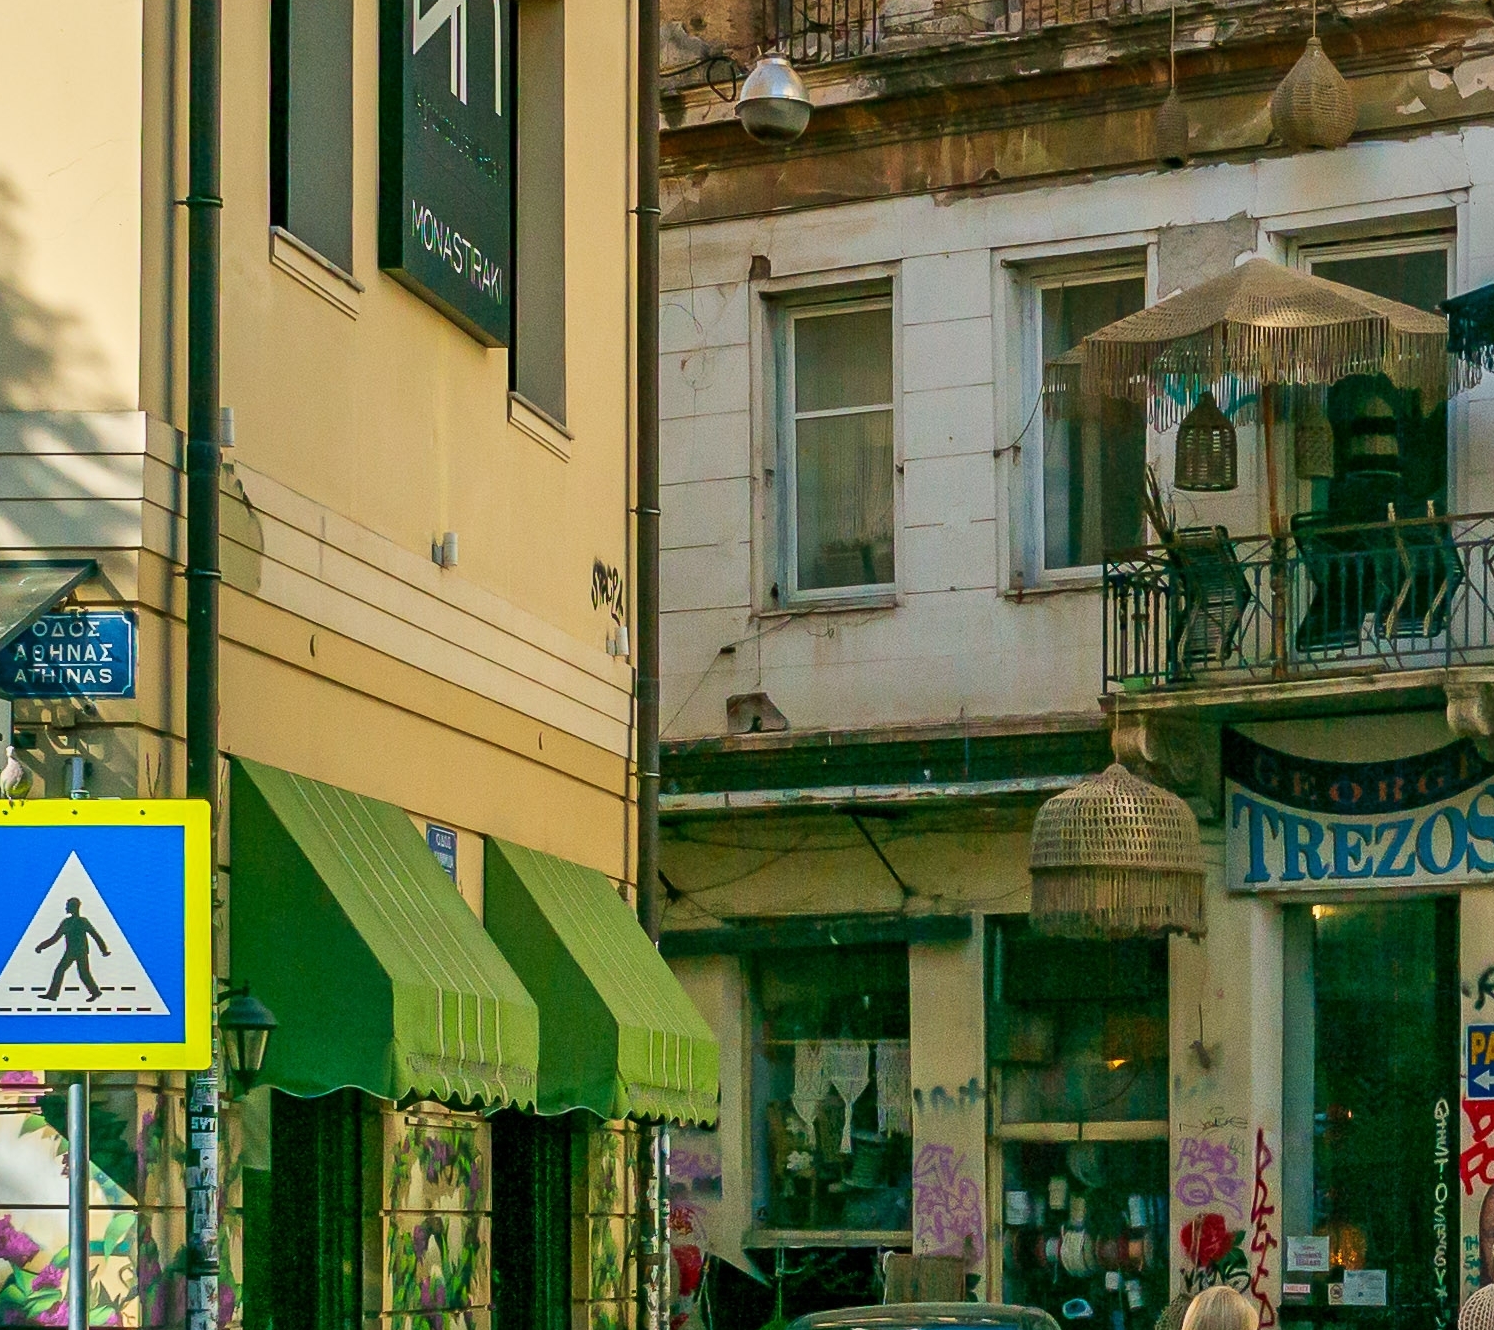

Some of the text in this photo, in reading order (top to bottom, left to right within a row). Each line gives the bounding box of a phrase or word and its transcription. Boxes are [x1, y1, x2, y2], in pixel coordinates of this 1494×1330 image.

[411, 199, 503, 306] MONASTIRAKI
[32, 620, 100, 637] ΟΔΟΣ
[14, 643, 113, 662] ΑΘΗΝΑΣ
[14, 668, 113, 684] ATHINAS
